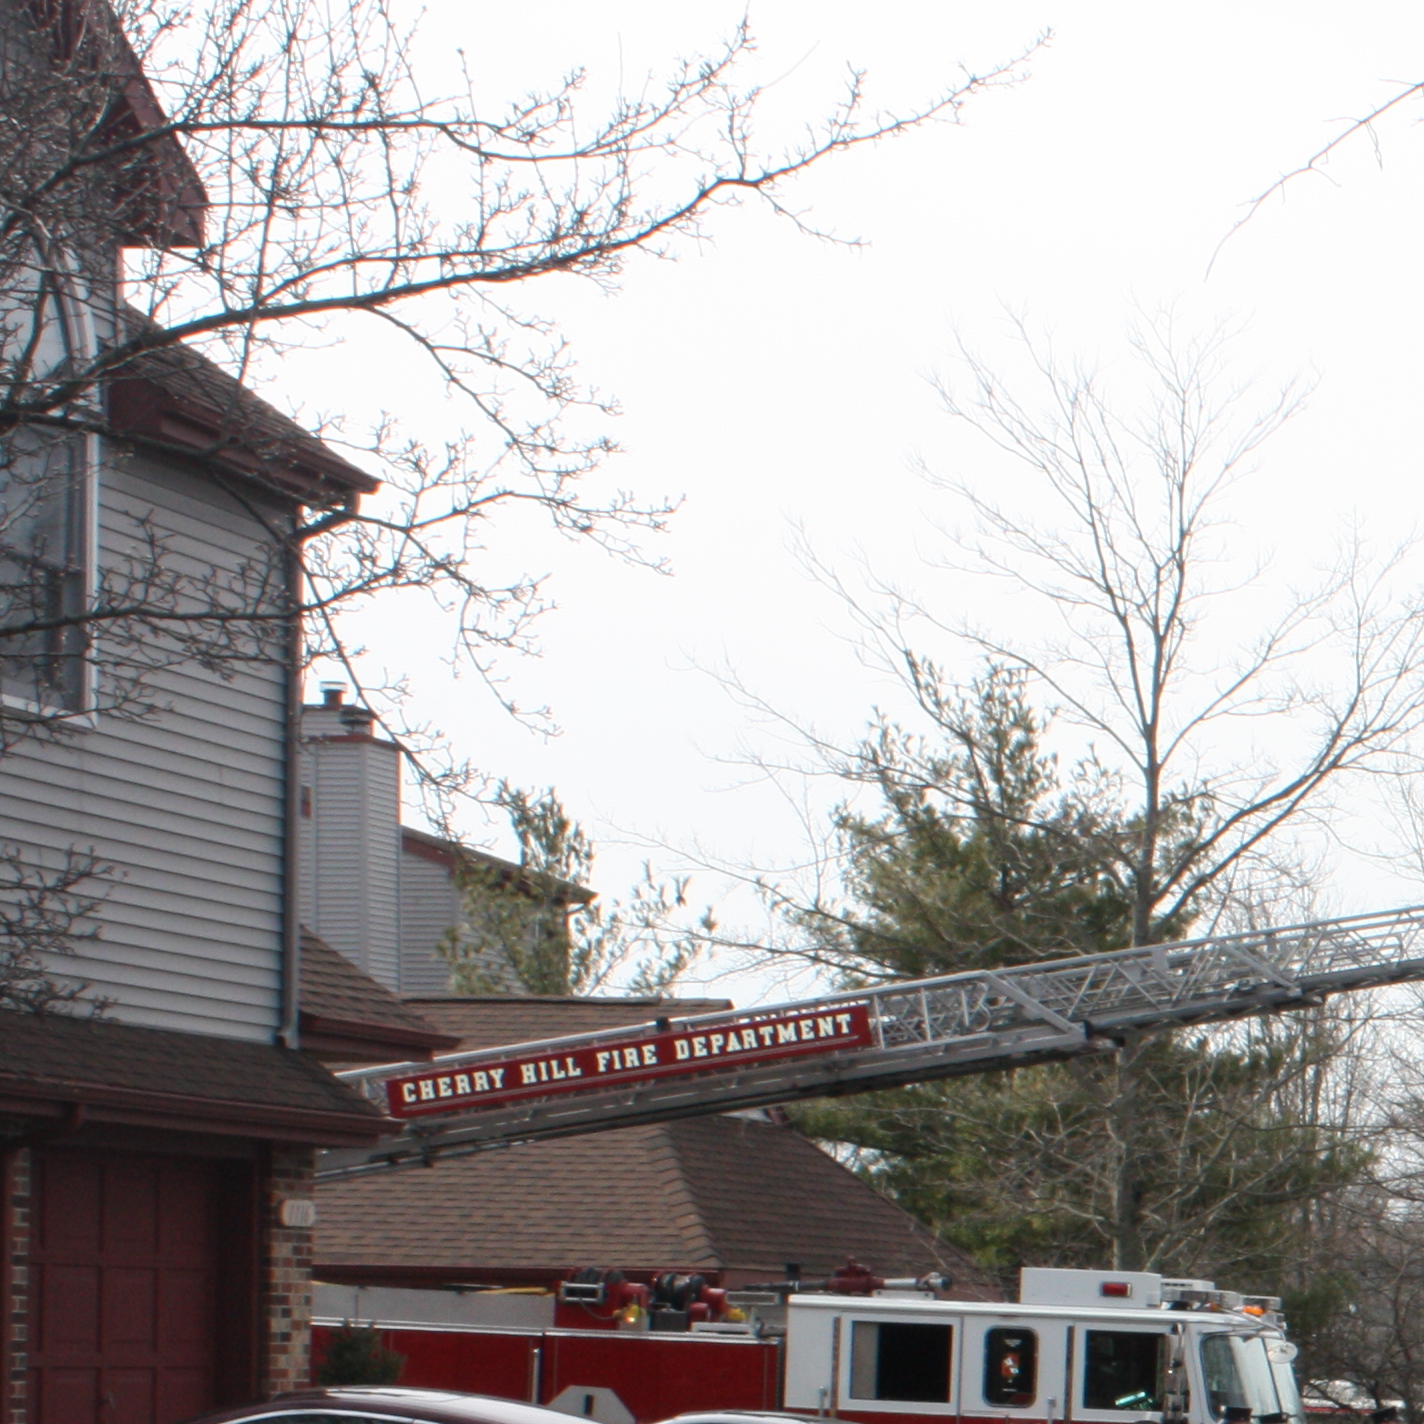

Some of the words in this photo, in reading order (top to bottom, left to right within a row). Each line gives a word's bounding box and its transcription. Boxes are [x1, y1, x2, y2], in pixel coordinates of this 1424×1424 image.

[402, 1068, 505, 1103] CHERRY
[520, 1057, 582, 1085] HILL
[596, 1044, 658, 1073] FIRE
[674, 1013, 852, 1061] DEPARTMENT
